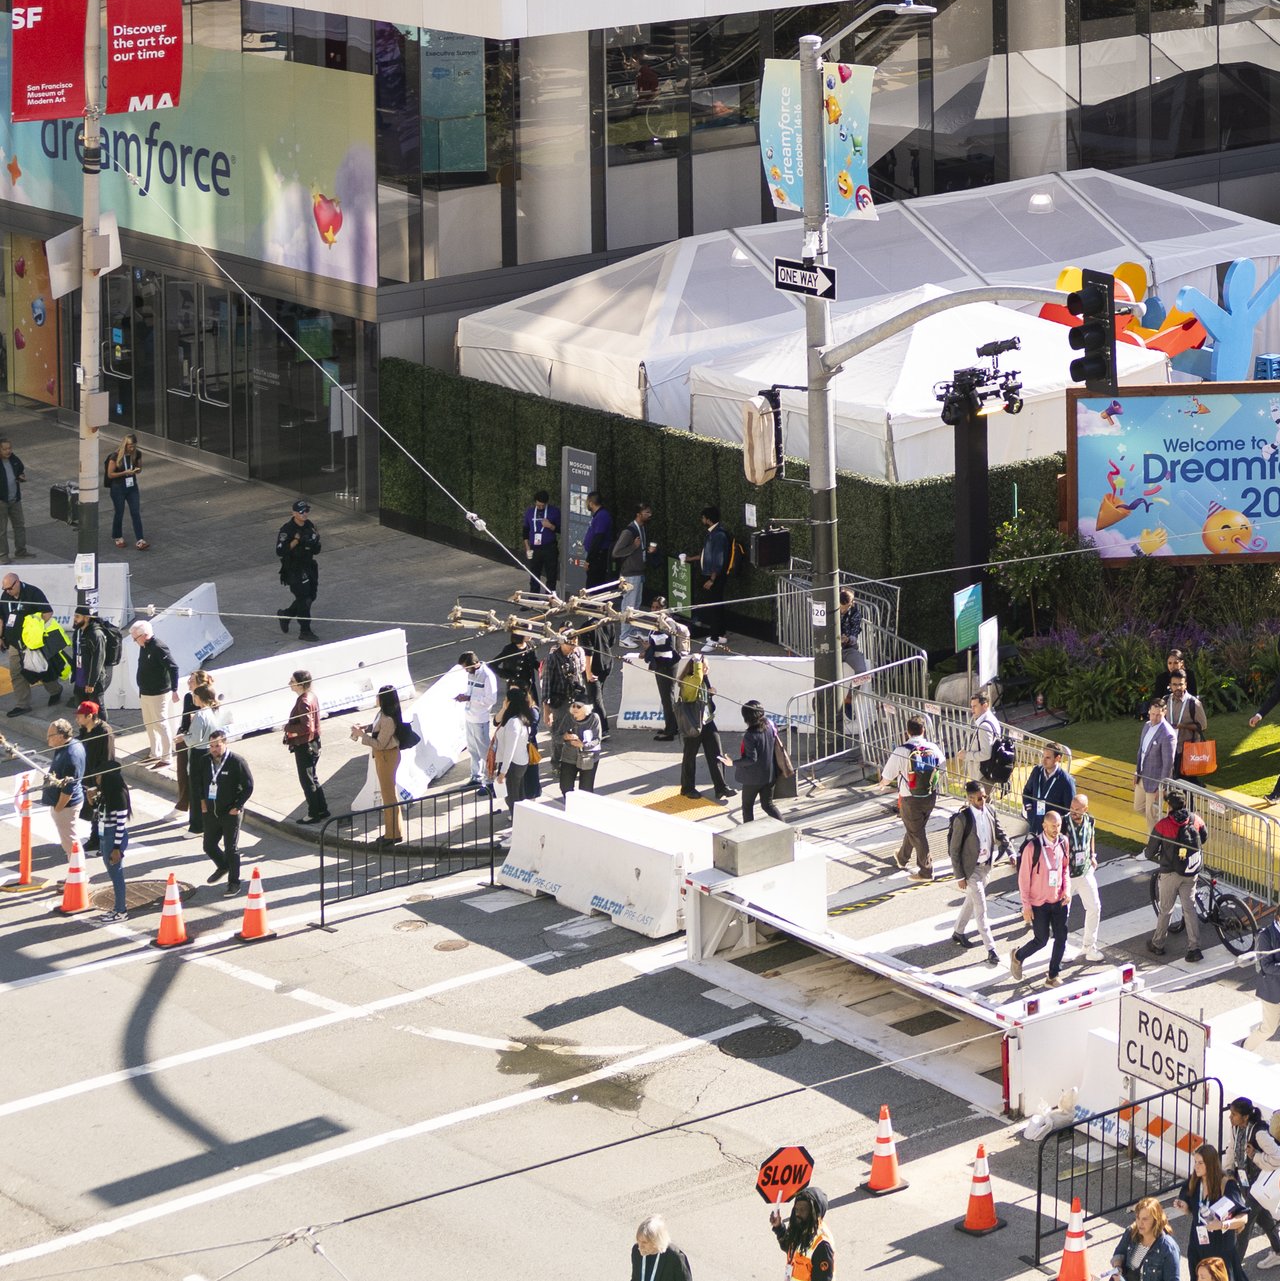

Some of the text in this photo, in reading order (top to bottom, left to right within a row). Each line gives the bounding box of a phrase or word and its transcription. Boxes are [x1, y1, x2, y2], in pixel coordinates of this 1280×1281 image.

[12, 6, 43, 30] SF
[113, 23, 167, 37] Discover
[113, 34, 178, 49] the art for
[113, 48, 165, 62] our time
[27, 82, 73, 92] San Francisco
[27, 88, 65, 99] Museum of
[27, 96, 66, 106] Modern Art
[128, 92, 174, 113] MA
[778, 86, 794, 186] dreamforce
[796, 137, 804, 178] October
[779, 268, 819, 289] ONE WAY
[1163, 436, 1268, 453] Welcome to
[569, 460, 593, 471] MOSCONE
[571, 468, 590, 476] CENTER
[501, 863, 562, 894] CHAPIN PRE-CAST
[591, 894, 654, 926] CHAPIN PRE-CAST
[1138, 1010, 1189, 1054] ROAD
[1126, 1040, 1198, 1093] CLOSED
[761, 1164, 809, 1187] SLOW
